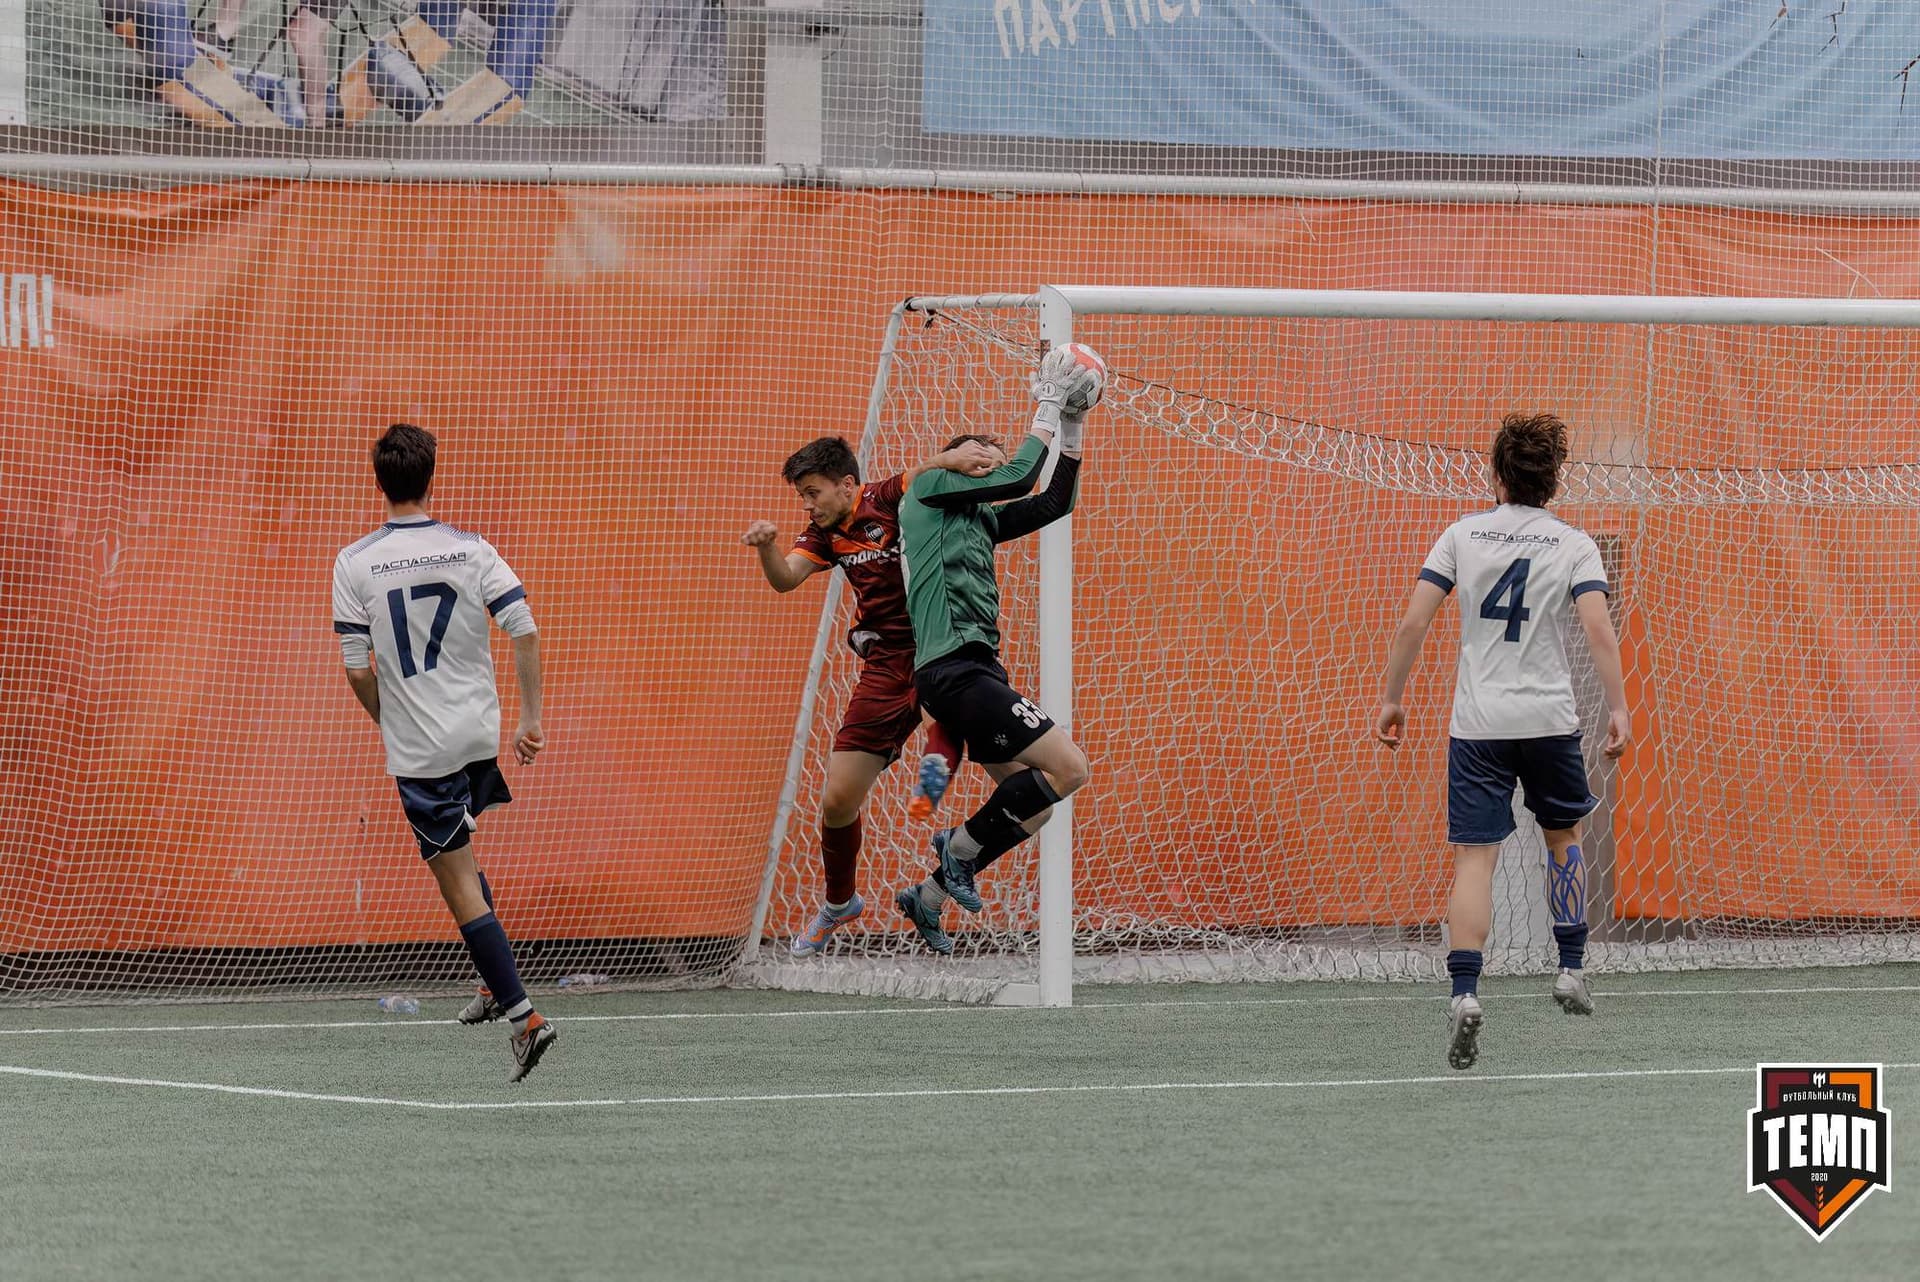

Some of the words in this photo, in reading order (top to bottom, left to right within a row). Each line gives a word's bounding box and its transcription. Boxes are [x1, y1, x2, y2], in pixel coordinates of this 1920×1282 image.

[0, 272, 54, 348] П!
[371, 552, 467, 576] РАСПАДСКАЯ
[1470, 530, 1560, 546] РАСПАДСКАЯ
[1480, 558, 1531, 642] 4
[387, 582, 458, 679] 17
[1011, 697, 1048, 729] 33
